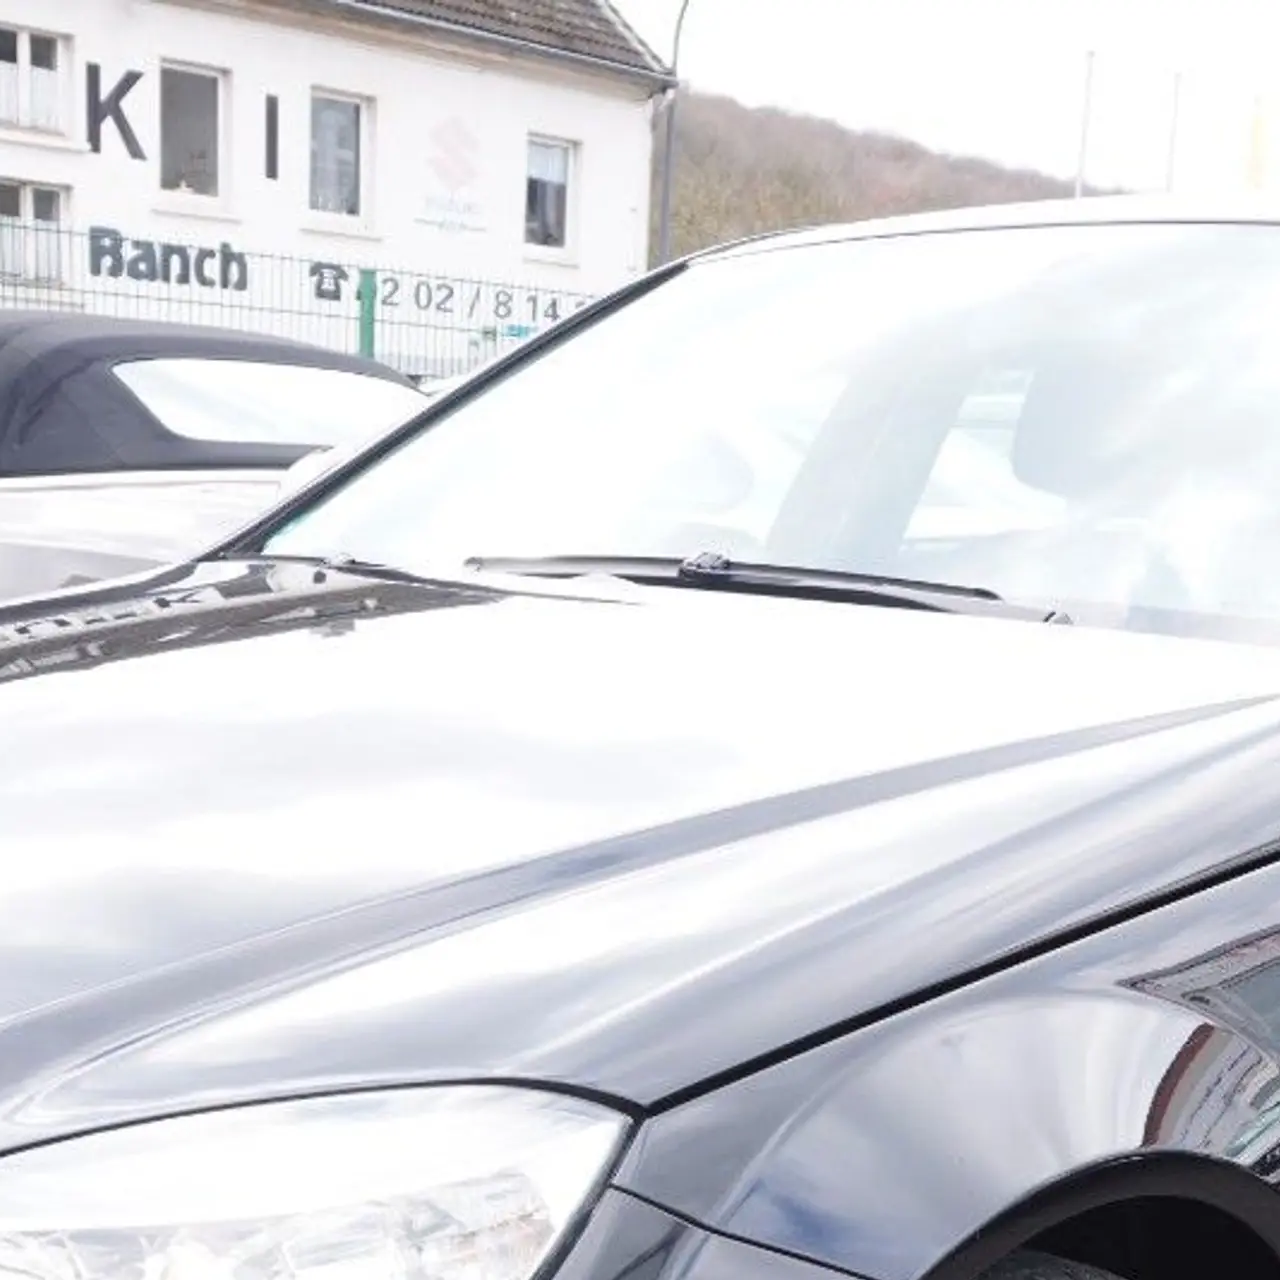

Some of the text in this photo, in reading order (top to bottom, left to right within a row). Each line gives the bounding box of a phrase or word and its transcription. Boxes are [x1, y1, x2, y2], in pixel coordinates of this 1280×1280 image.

[89, 226, 249, 293] Ranch
[414, 281, 455, 314] 02
[493, 289, 513, 319] 8
[525, 293, 562, 322] 14
